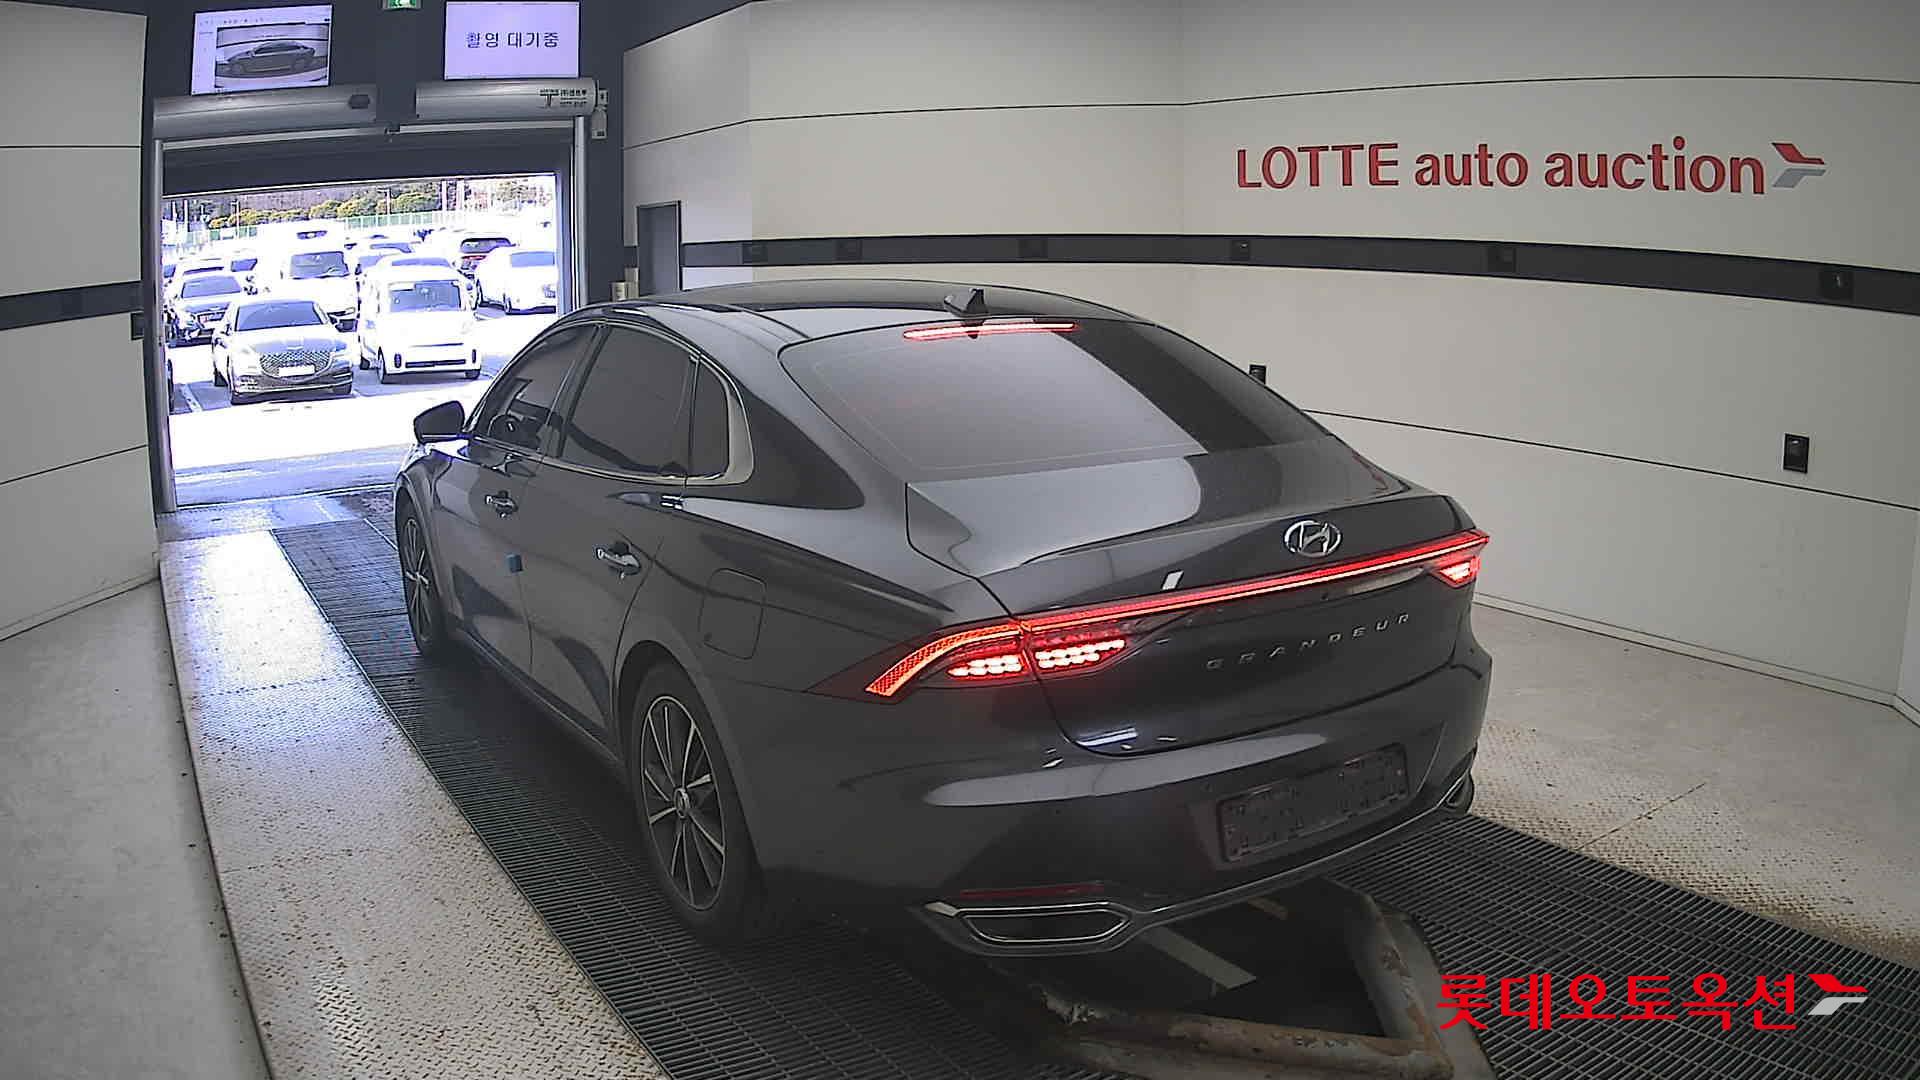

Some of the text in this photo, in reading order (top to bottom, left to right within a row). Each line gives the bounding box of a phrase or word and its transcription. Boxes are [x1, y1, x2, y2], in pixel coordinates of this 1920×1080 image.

[507, 31, 559, 48] 대기중
[1237, 136, 1765, 194] LOTTE auto auction
[1205, 612, 1409, 671] GRANDEUR
